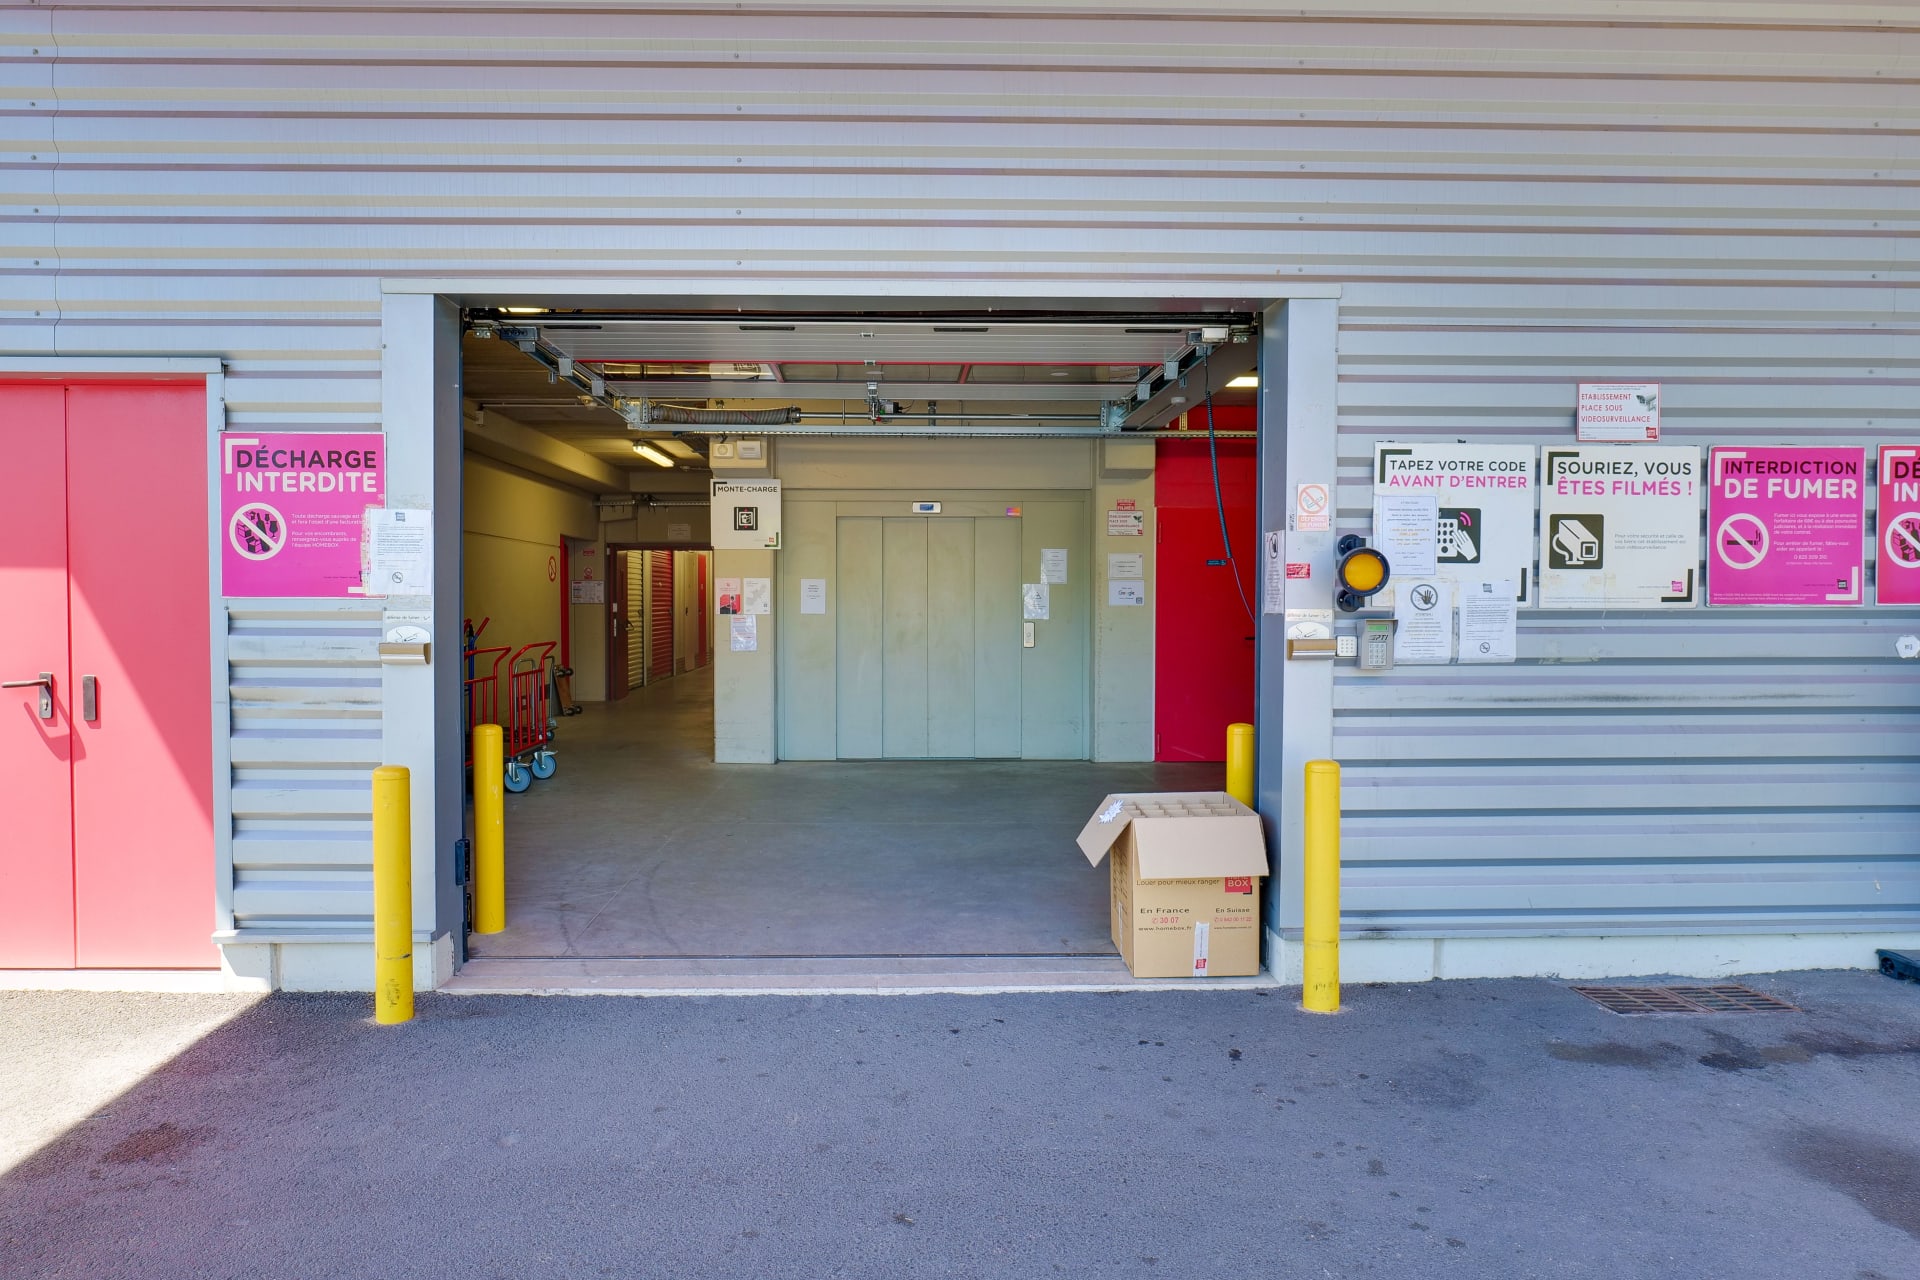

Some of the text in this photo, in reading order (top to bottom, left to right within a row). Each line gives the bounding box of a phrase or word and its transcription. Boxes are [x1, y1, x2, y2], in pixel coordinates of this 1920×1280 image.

[1581, 415, 1651, 423] VIDEOSURVEILLANCE
[236, 445, 377, 469] DÉCHARGE
[1390, 460, 1527, 472] TAPEZ VOTRE CODE
[1557, 461, 1692, 477] SOURIEZ, VOUS
[1724, 460, 1857, 475] INTERDICTION
[236, 472, 377, 493] INTERDITE
[1389, 475, 1445, 488] AVANT
[1557, 476, 1693, 496] ÊTES FILMÉS !
[1724, 478, 1857, 500] DE FUMER
